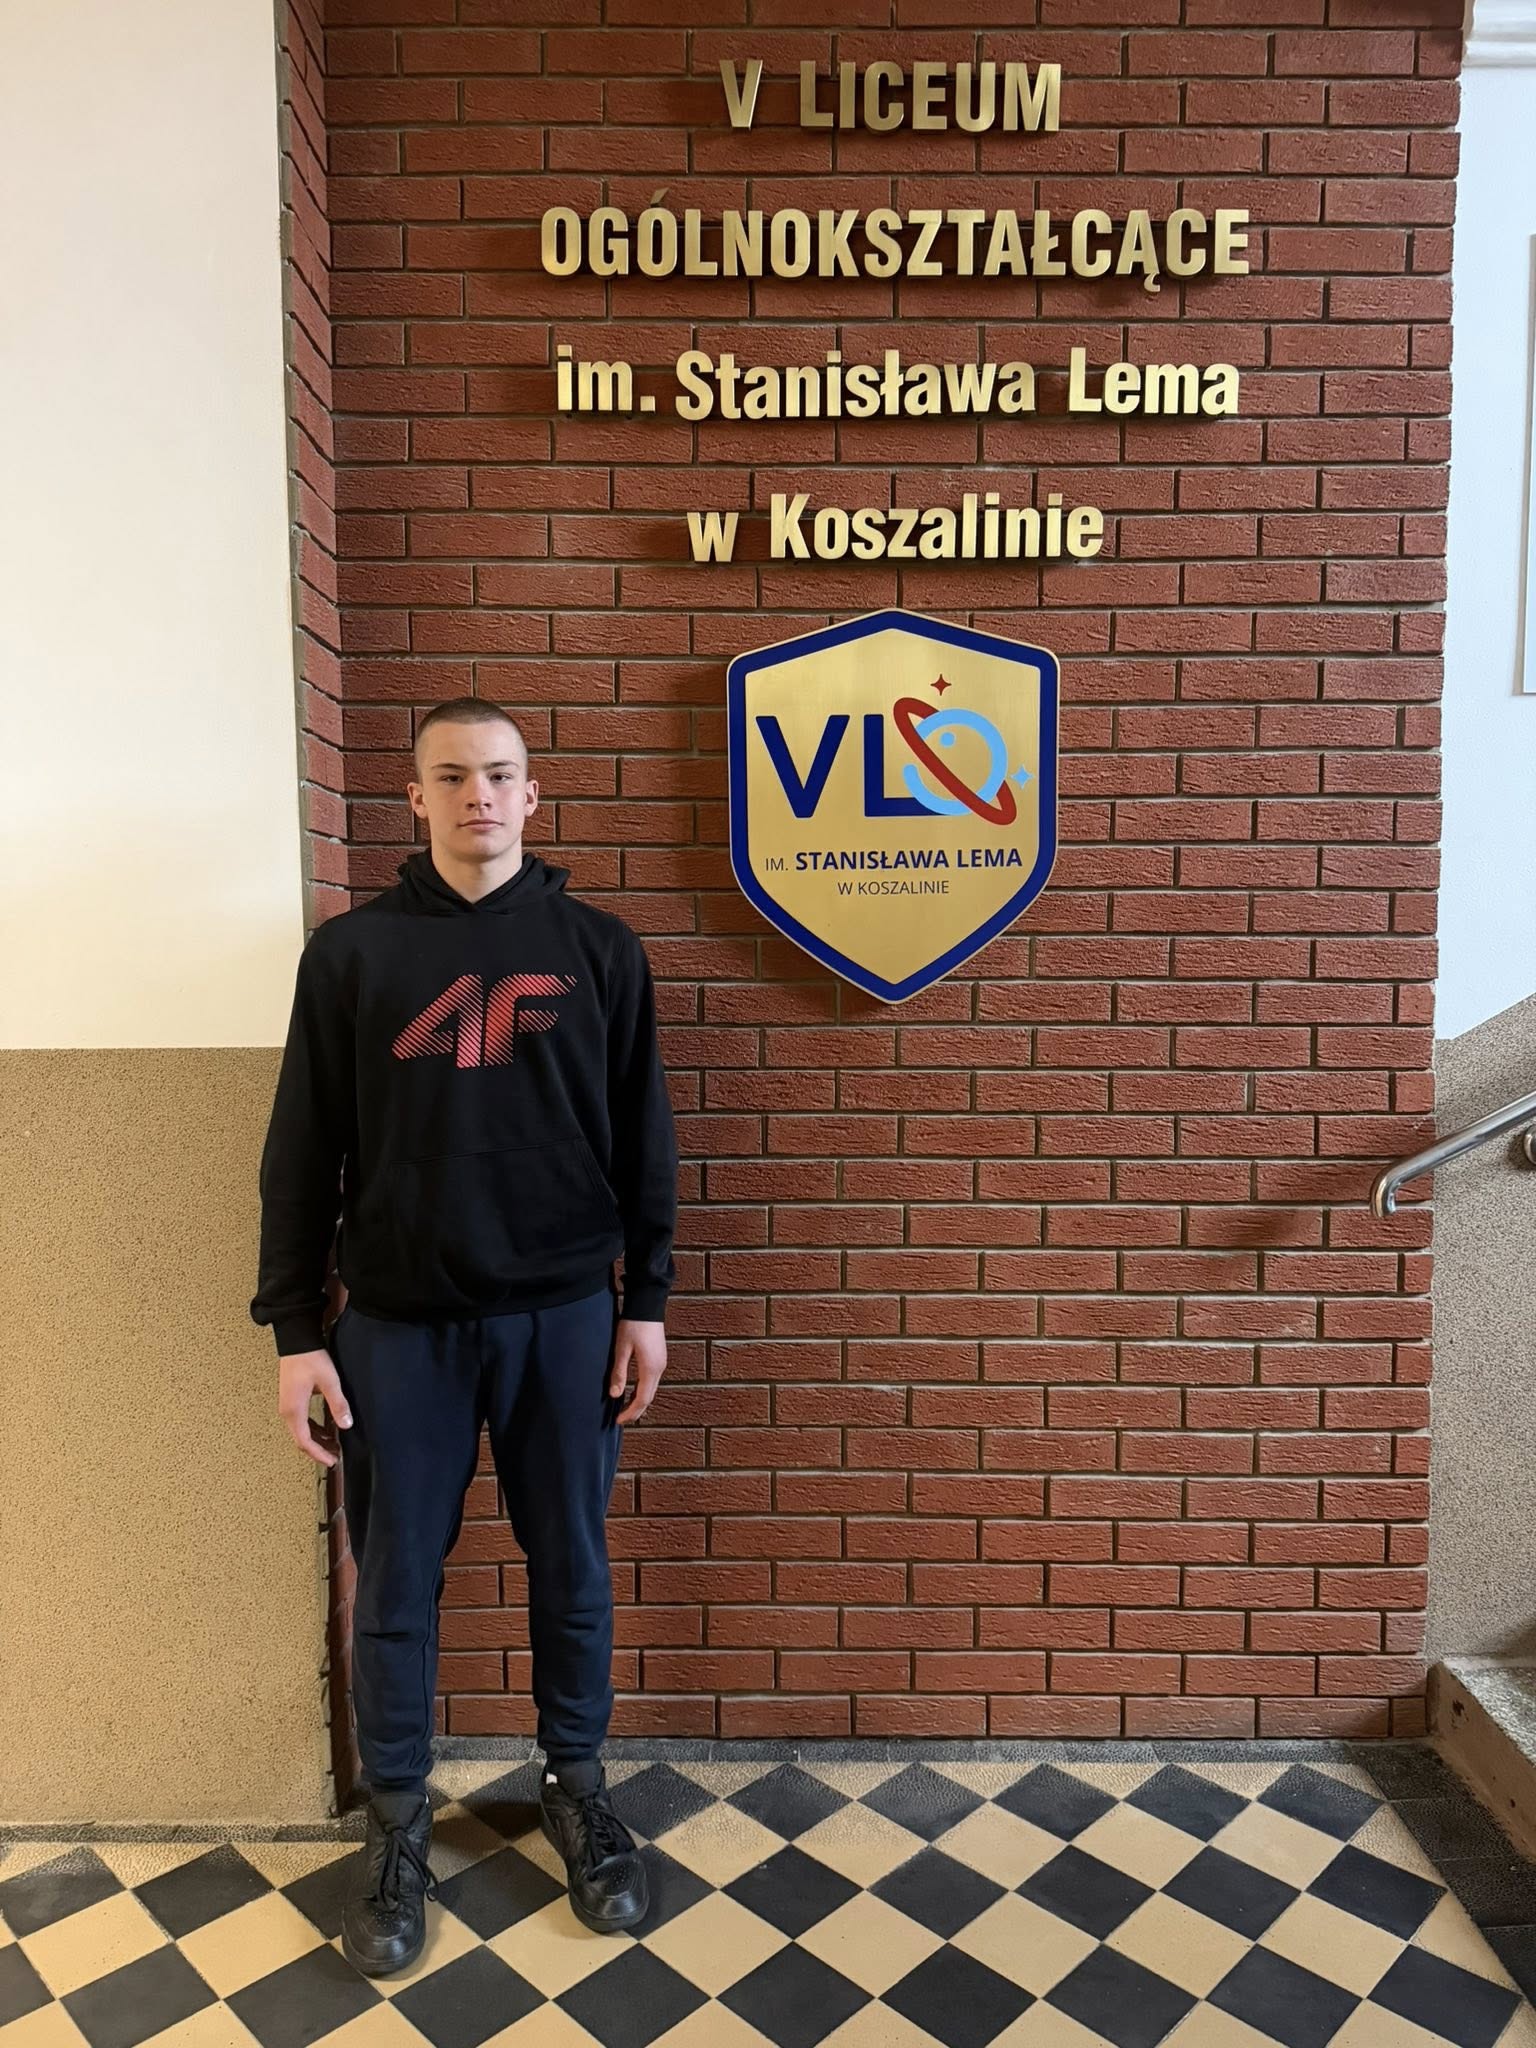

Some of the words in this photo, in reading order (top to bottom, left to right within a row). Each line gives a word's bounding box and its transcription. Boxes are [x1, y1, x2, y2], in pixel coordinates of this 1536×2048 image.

[719, 59, 763, 130] V
[800, 60, 1062, 133] LICEUM
[540, 187, 1250, 293] OGÓLNOKSZTAŁCĄCE
[556, 345, 656, 413] im.
[675, 349, 1036, 421] Stanisława
[1068, 346, 1240, 416] Lema
[687, 511, 739, 563] w
[770, 492, 1104, 560] Koszalinie
[765, 857, 789, 871] IM.
[795, 849, 950, 871] STANISŁAWA
[957, 848, 1023, 868] LEMA
[837, 881, 853, 895] W
[858, 879, 950, 896] KOSZALINIE
[392, 974, 577, 1068] 4F
